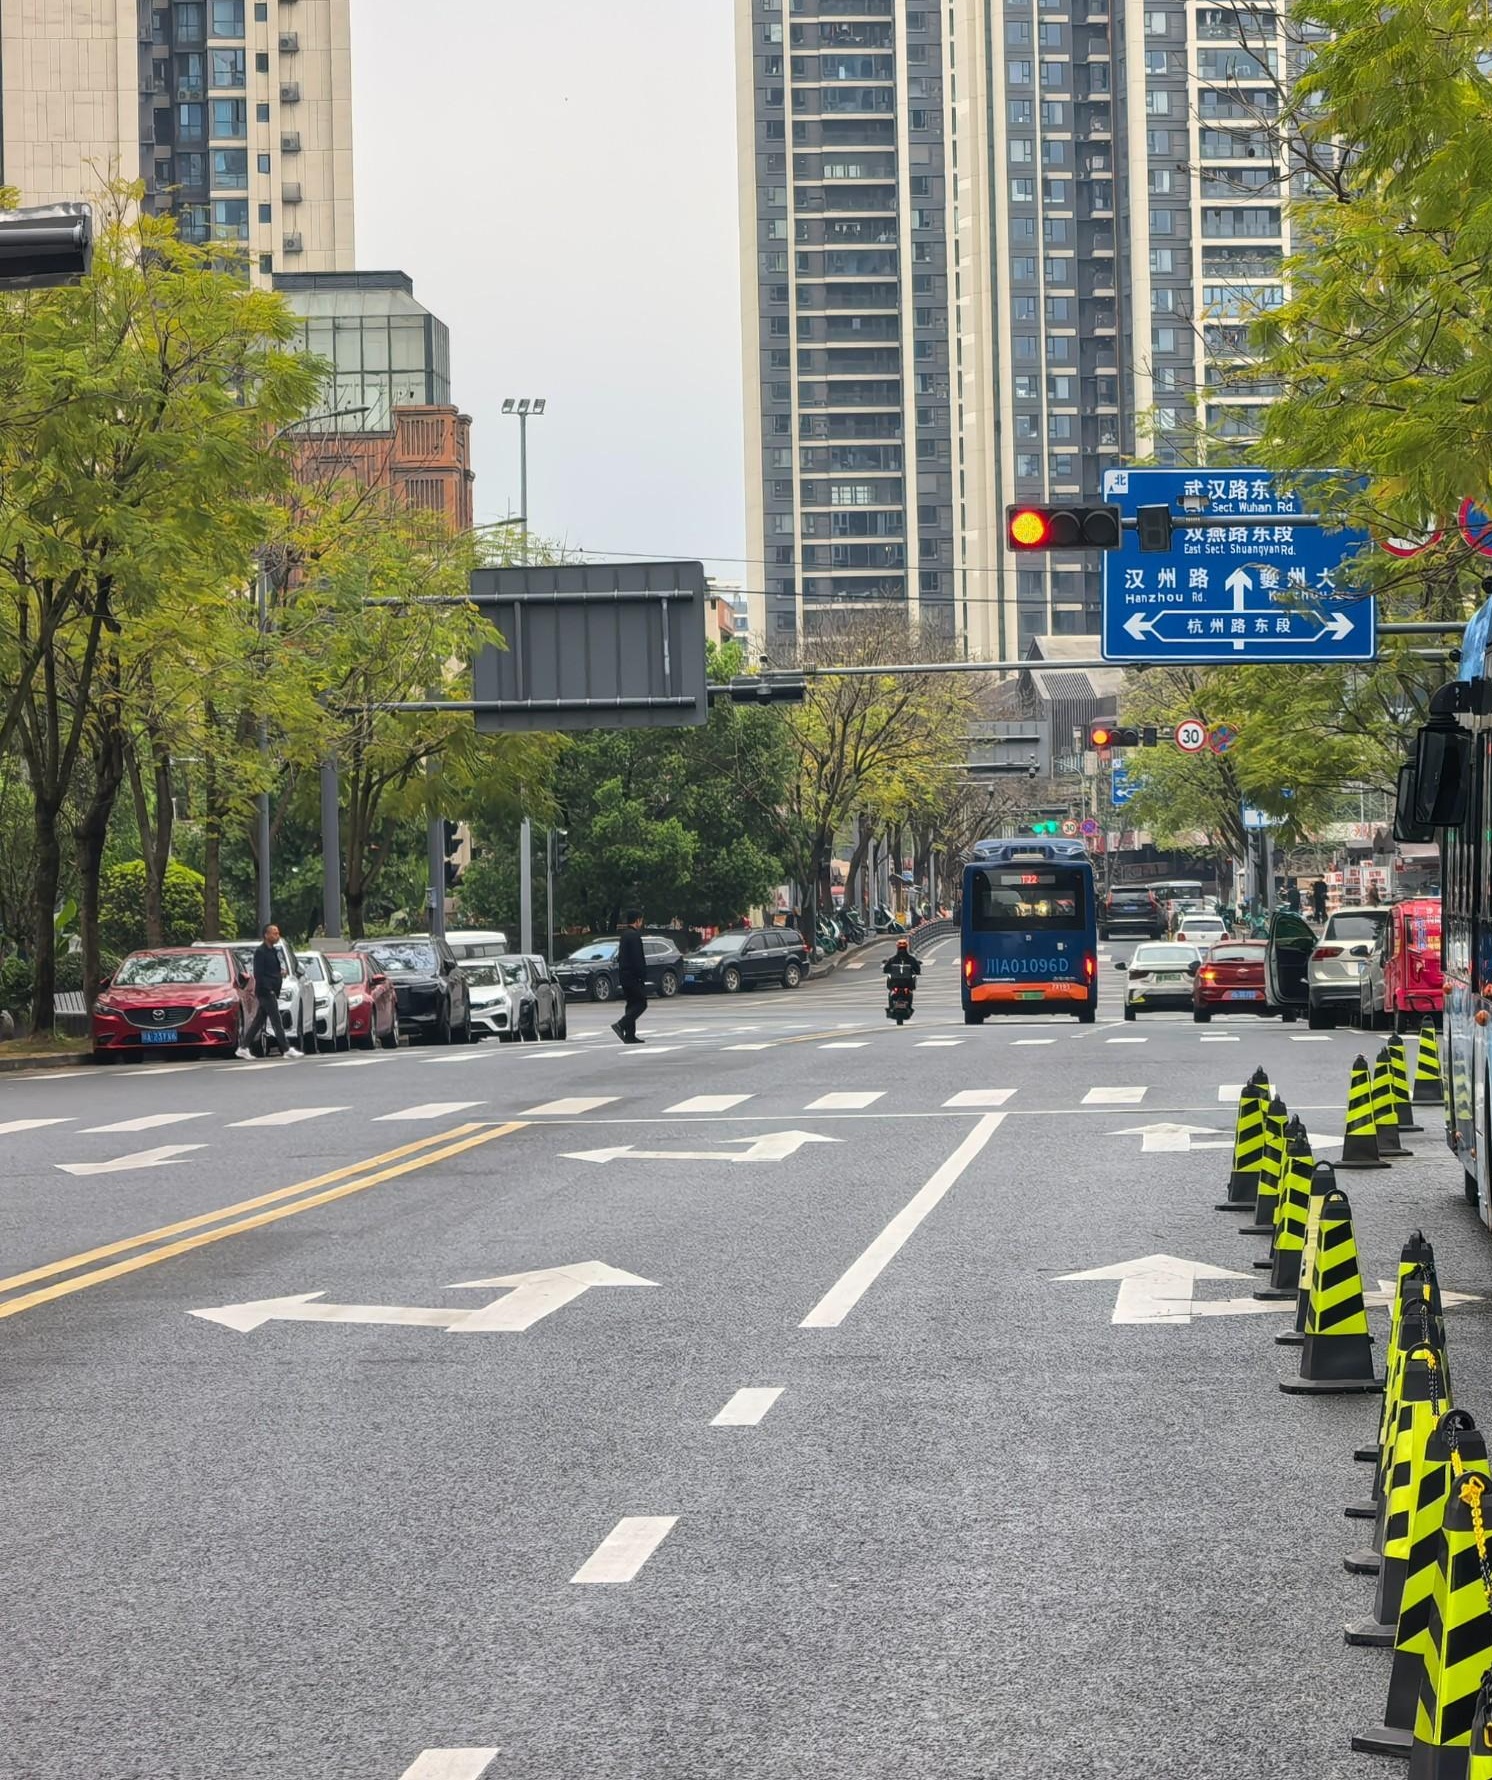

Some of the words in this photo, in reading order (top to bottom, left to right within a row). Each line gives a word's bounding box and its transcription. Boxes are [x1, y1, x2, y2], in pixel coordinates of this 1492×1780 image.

[1114, 474, 1126, 486] 北
[1212, 502, 1235, 513] Sect.
[1239, 502, 1272, 513] Wuhan
[1277, 501, 1296, 512] Rd.
[1184, 544, 1201, 554] East
[1230, 544, 1280, 556] Shuangyan
[1281, 545, 1296, 555] Rd.
[1124, 567, 1209, 589] 汉州路
[1260, 566, 1357, 589] 夔州大
[1125, 592, 1183, 604] Hanzhou
[1192, 592, 1207, 603] Rd.
[1187, 617, 1291, 634] 杭州路东段
[1182, 729, 1200, 744] 30
[986, 958, 1069, 974] 川A01096D
